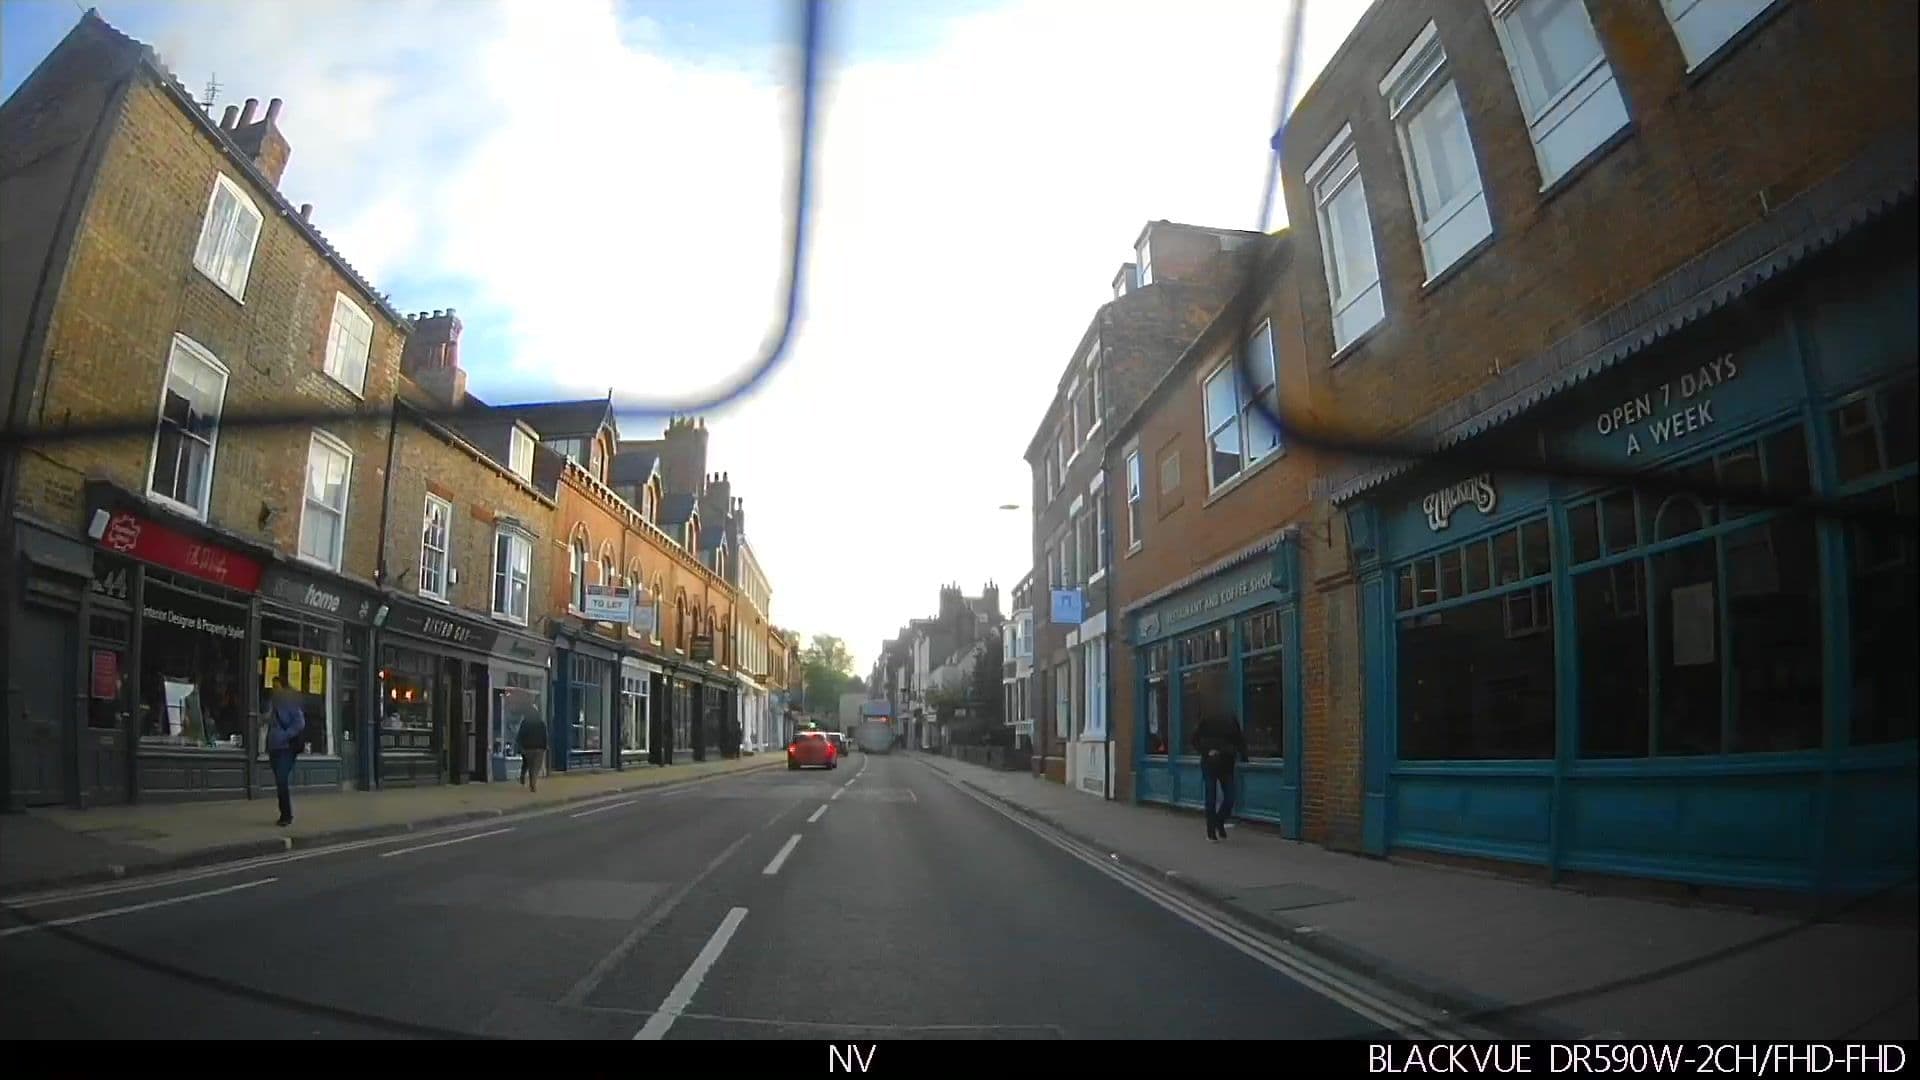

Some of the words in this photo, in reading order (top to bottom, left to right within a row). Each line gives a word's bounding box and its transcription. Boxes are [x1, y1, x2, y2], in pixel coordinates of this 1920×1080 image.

[1597, 393, 1651, 435] OPEN
[1659, 382, 1670, 408] 7
[1680, 352, 1738, 397] DAYS
[1626, 433, 1641, 456] A
[1649, 400, 1714, 445] WEEK
[304, 583, 341, 612] home
[592, 599, 605, 608] TO
[606, 600, 622, 609] LET
[1205, 596, 1219, 612] AND
[1220, 582, 1248, 602] COFFEE
[1249, 571, 1272, 592] SHOP
[168, 610, 195, 629] Designer
